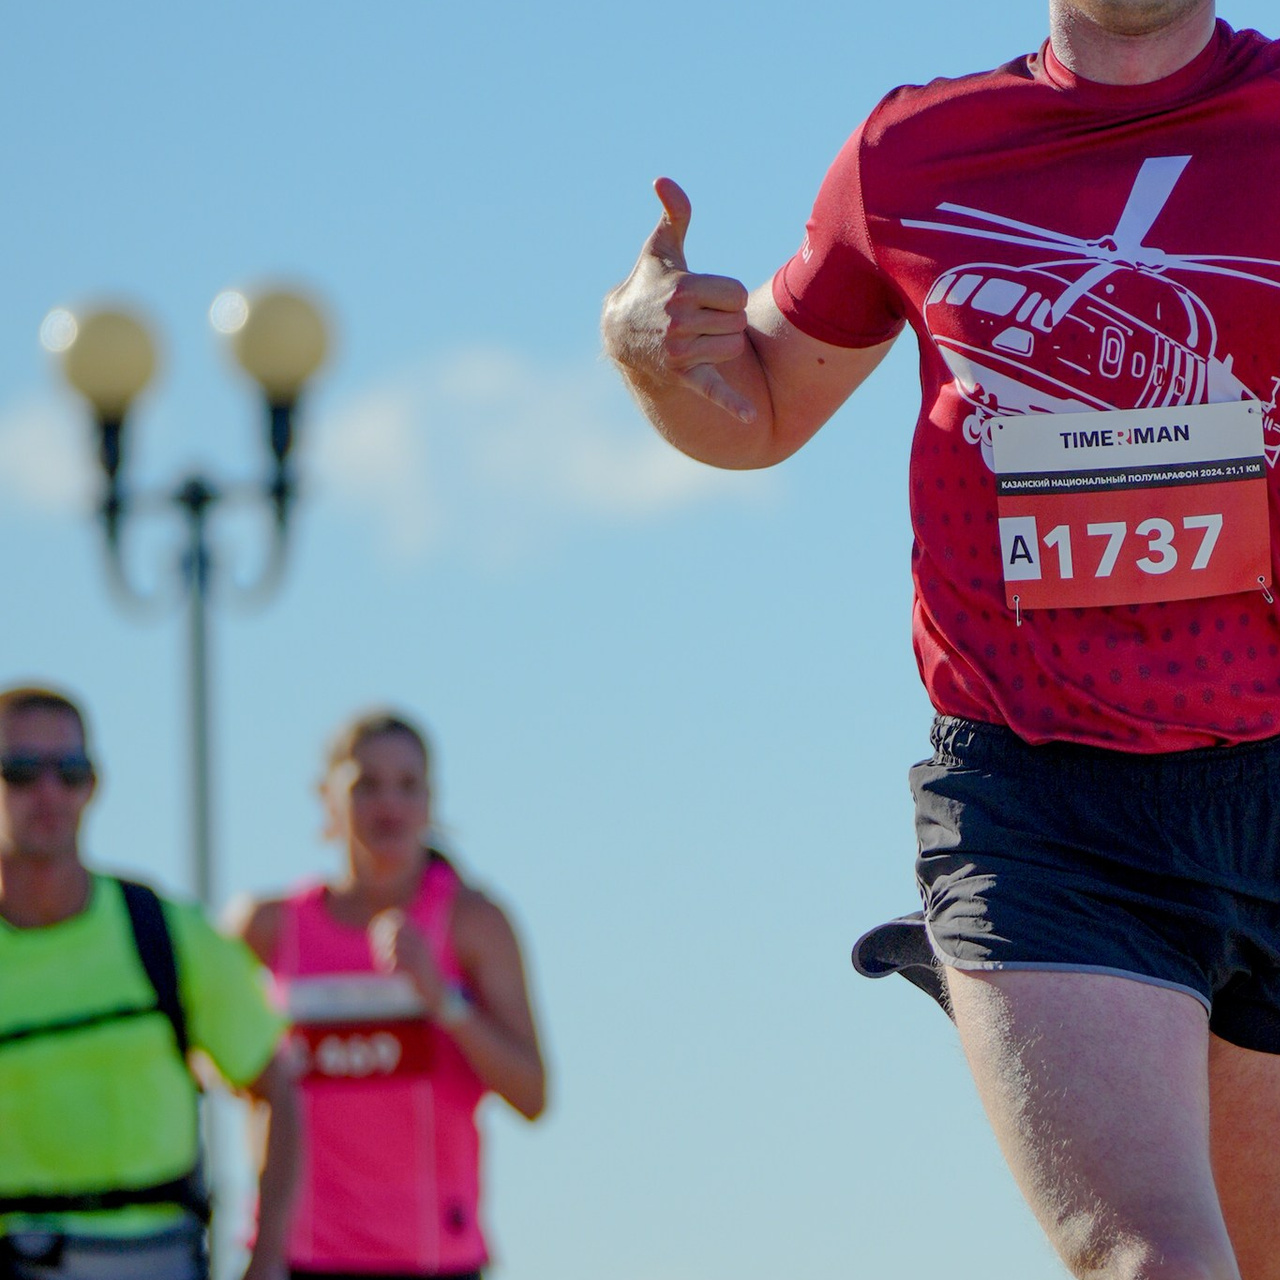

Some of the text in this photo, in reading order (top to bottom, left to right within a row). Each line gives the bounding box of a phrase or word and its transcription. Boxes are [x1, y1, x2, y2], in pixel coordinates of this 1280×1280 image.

[1001, 478, 1051, 489] КАЗАНСКИЙ
[1051, 474, 1127, 488] НАЦИОНАЛЬНЫЙ
[1128, 470, 1199, 483] ПОЛУМАРАФОН
[1226, 465, 1244, 475] 21,1
[1246, 464, 1260, 473] КМ
[1043, 513, 1223, 580] 1737
